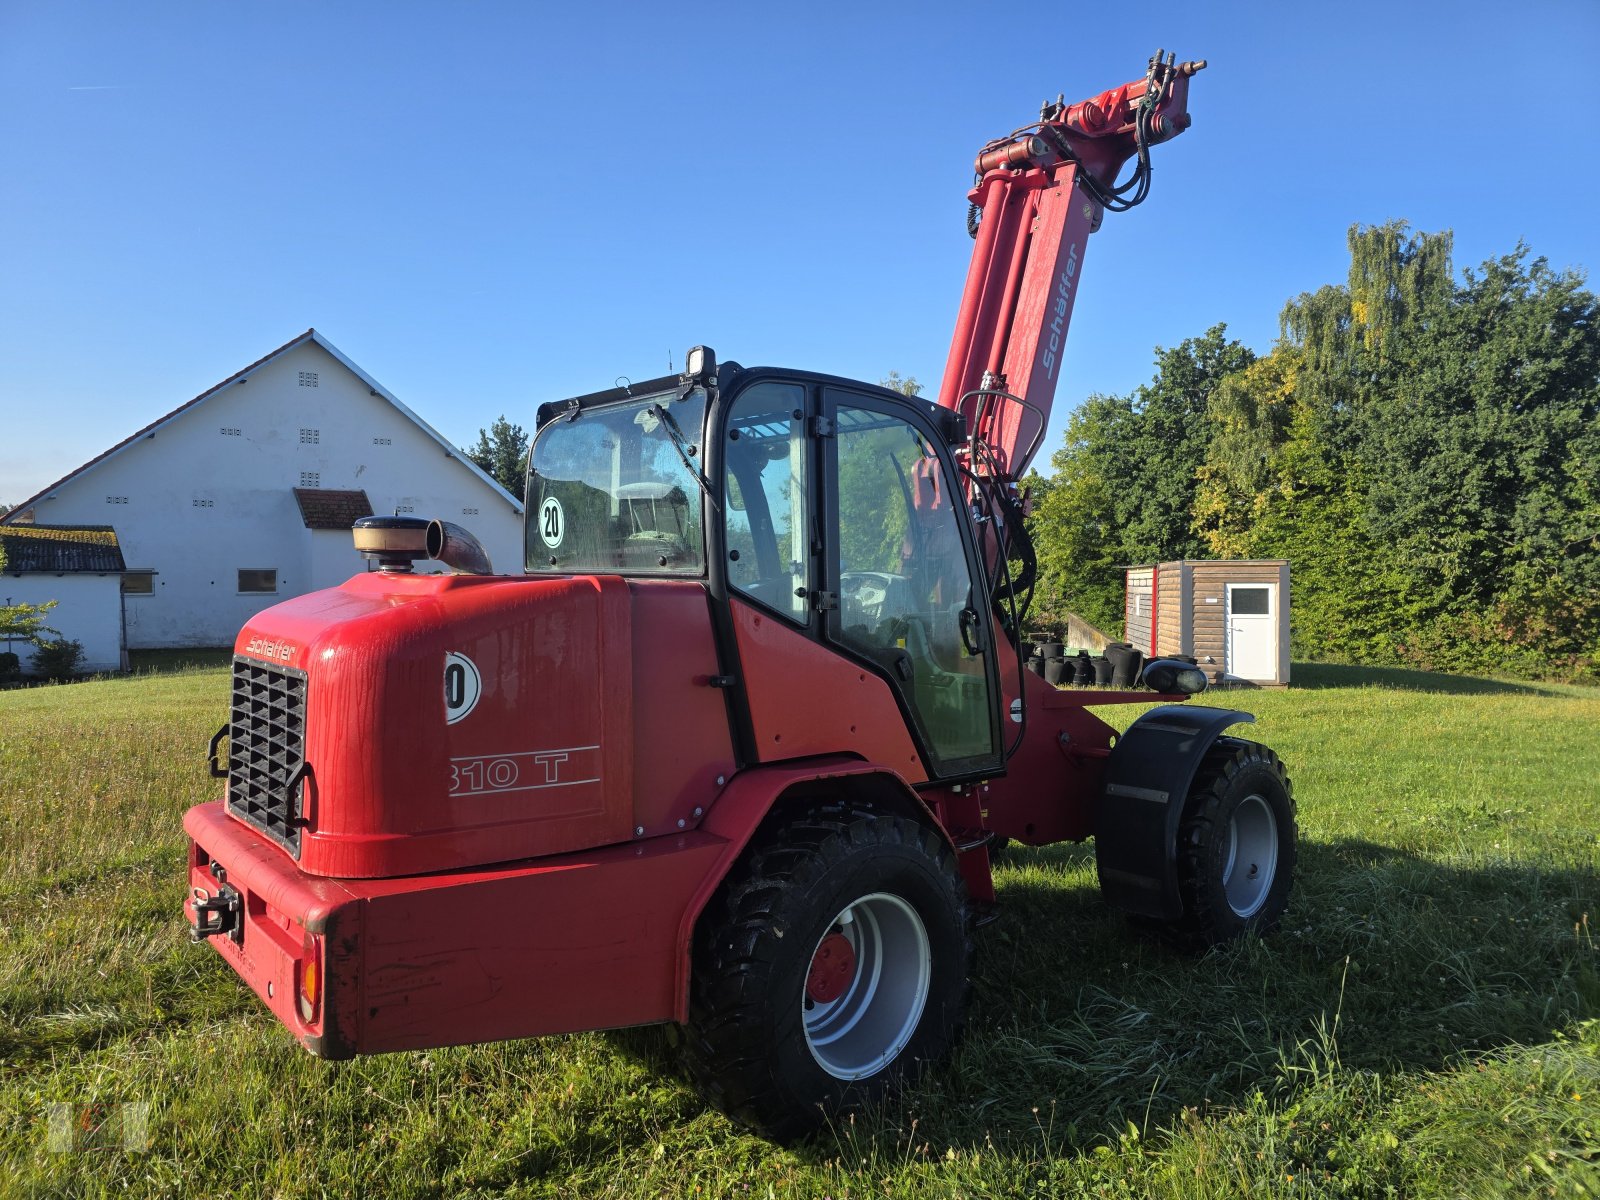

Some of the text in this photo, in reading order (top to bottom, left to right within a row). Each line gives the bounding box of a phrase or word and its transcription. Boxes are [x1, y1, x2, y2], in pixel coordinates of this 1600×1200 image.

[1042, 243, 1078, 380] Schäffer
[544, 505, 559, 538] 20
[535, 753, 569, 783] T
